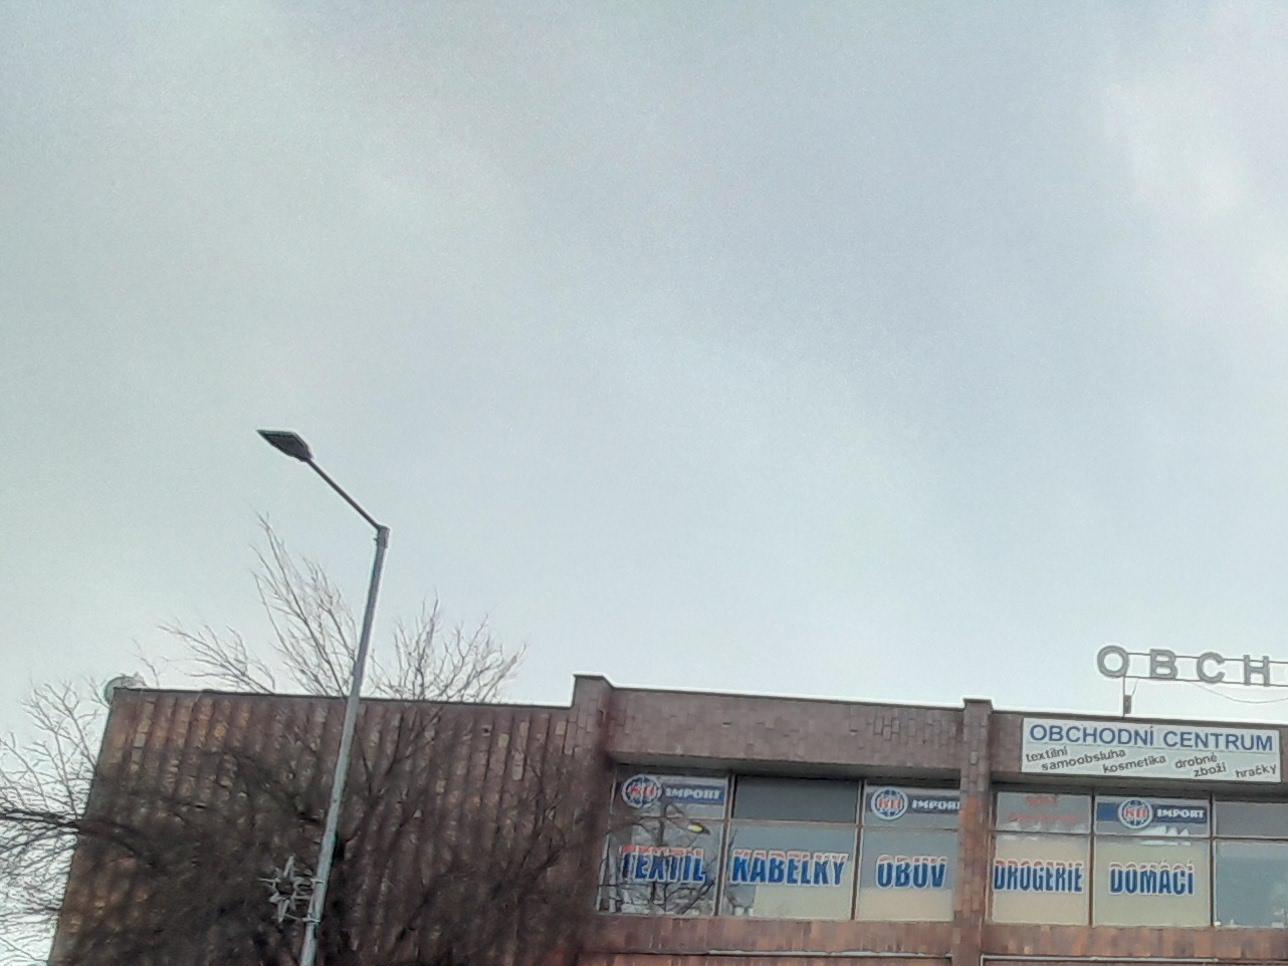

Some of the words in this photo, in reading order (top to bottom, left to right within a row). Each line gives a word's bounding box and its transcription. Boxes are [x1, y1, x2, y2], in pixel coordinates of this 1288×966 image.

[1029, 724, 1155, 747] OBCHODNÍ
[1163, 730, 1273, 751] CENTRUM
[1041, 749, 1127, 771] samoobsluha
[1103, 754, 1167, 774] kosmetika
[1175, 751, 1219, 769] drobné
[1193, 761, 1228, 777] zboží
[1235, 763, 1277, 779] hračky
[665, 786, 721, 799] IMPORT
[1157, 808, 1204, 819] IMPORT
[619, 844, 706, 883] TEXTIL
[728, 848, 850, 888] KABELKY
[875, 854, 949, 890] OBUV
[993, 858, 1085, 893] DROGERIE
[1109, 859, 1194, 897] DOMÁCÍ
